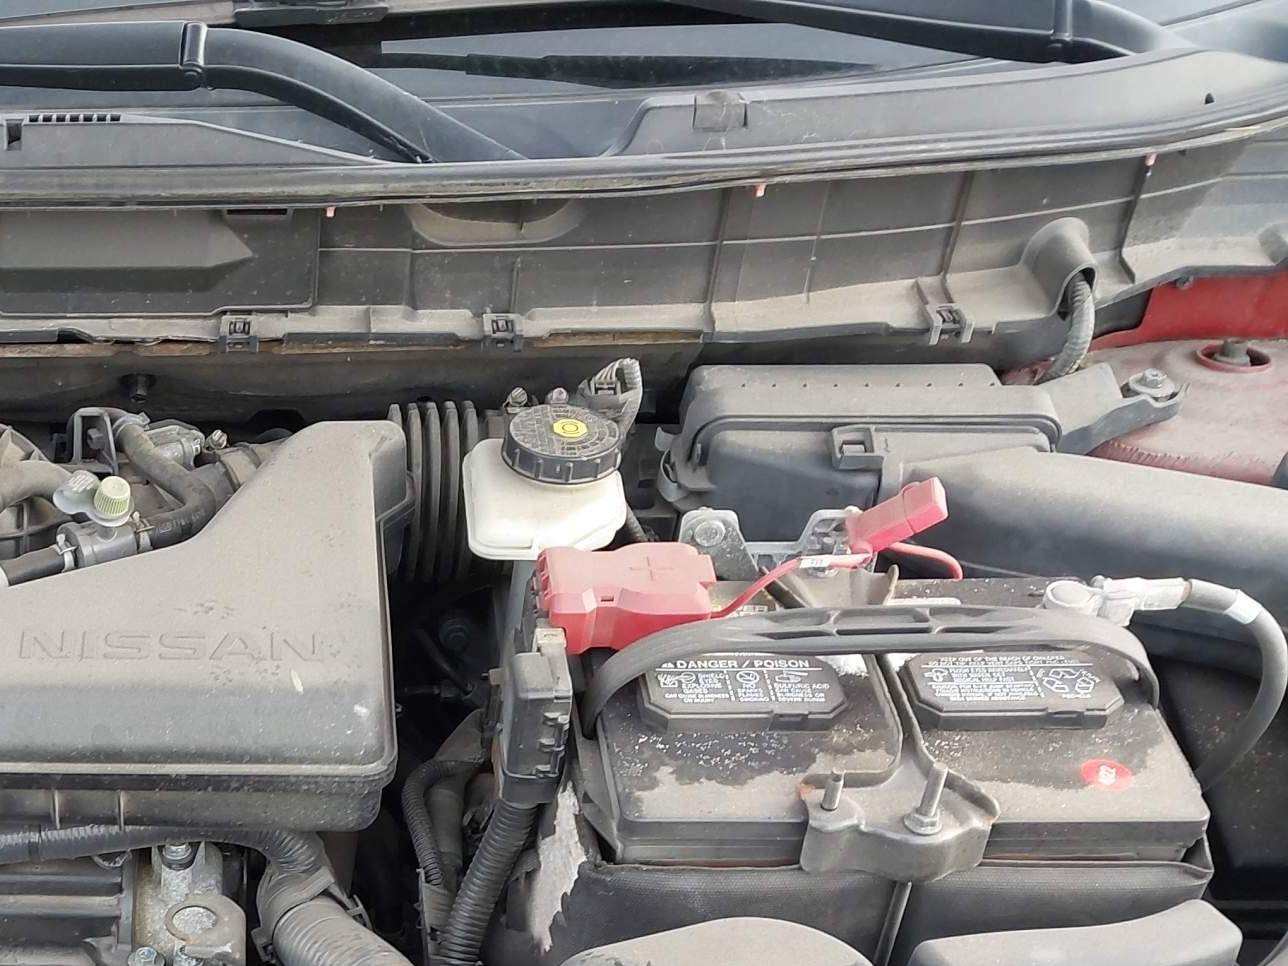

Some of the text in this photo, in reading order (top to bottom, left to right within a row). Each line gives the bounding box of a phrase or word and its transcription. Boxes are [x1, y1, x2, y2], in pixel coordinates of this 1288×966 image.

[18, 630, 325, 662] NISSAN
[676, 659, 810, 669] DANGER / POISON
